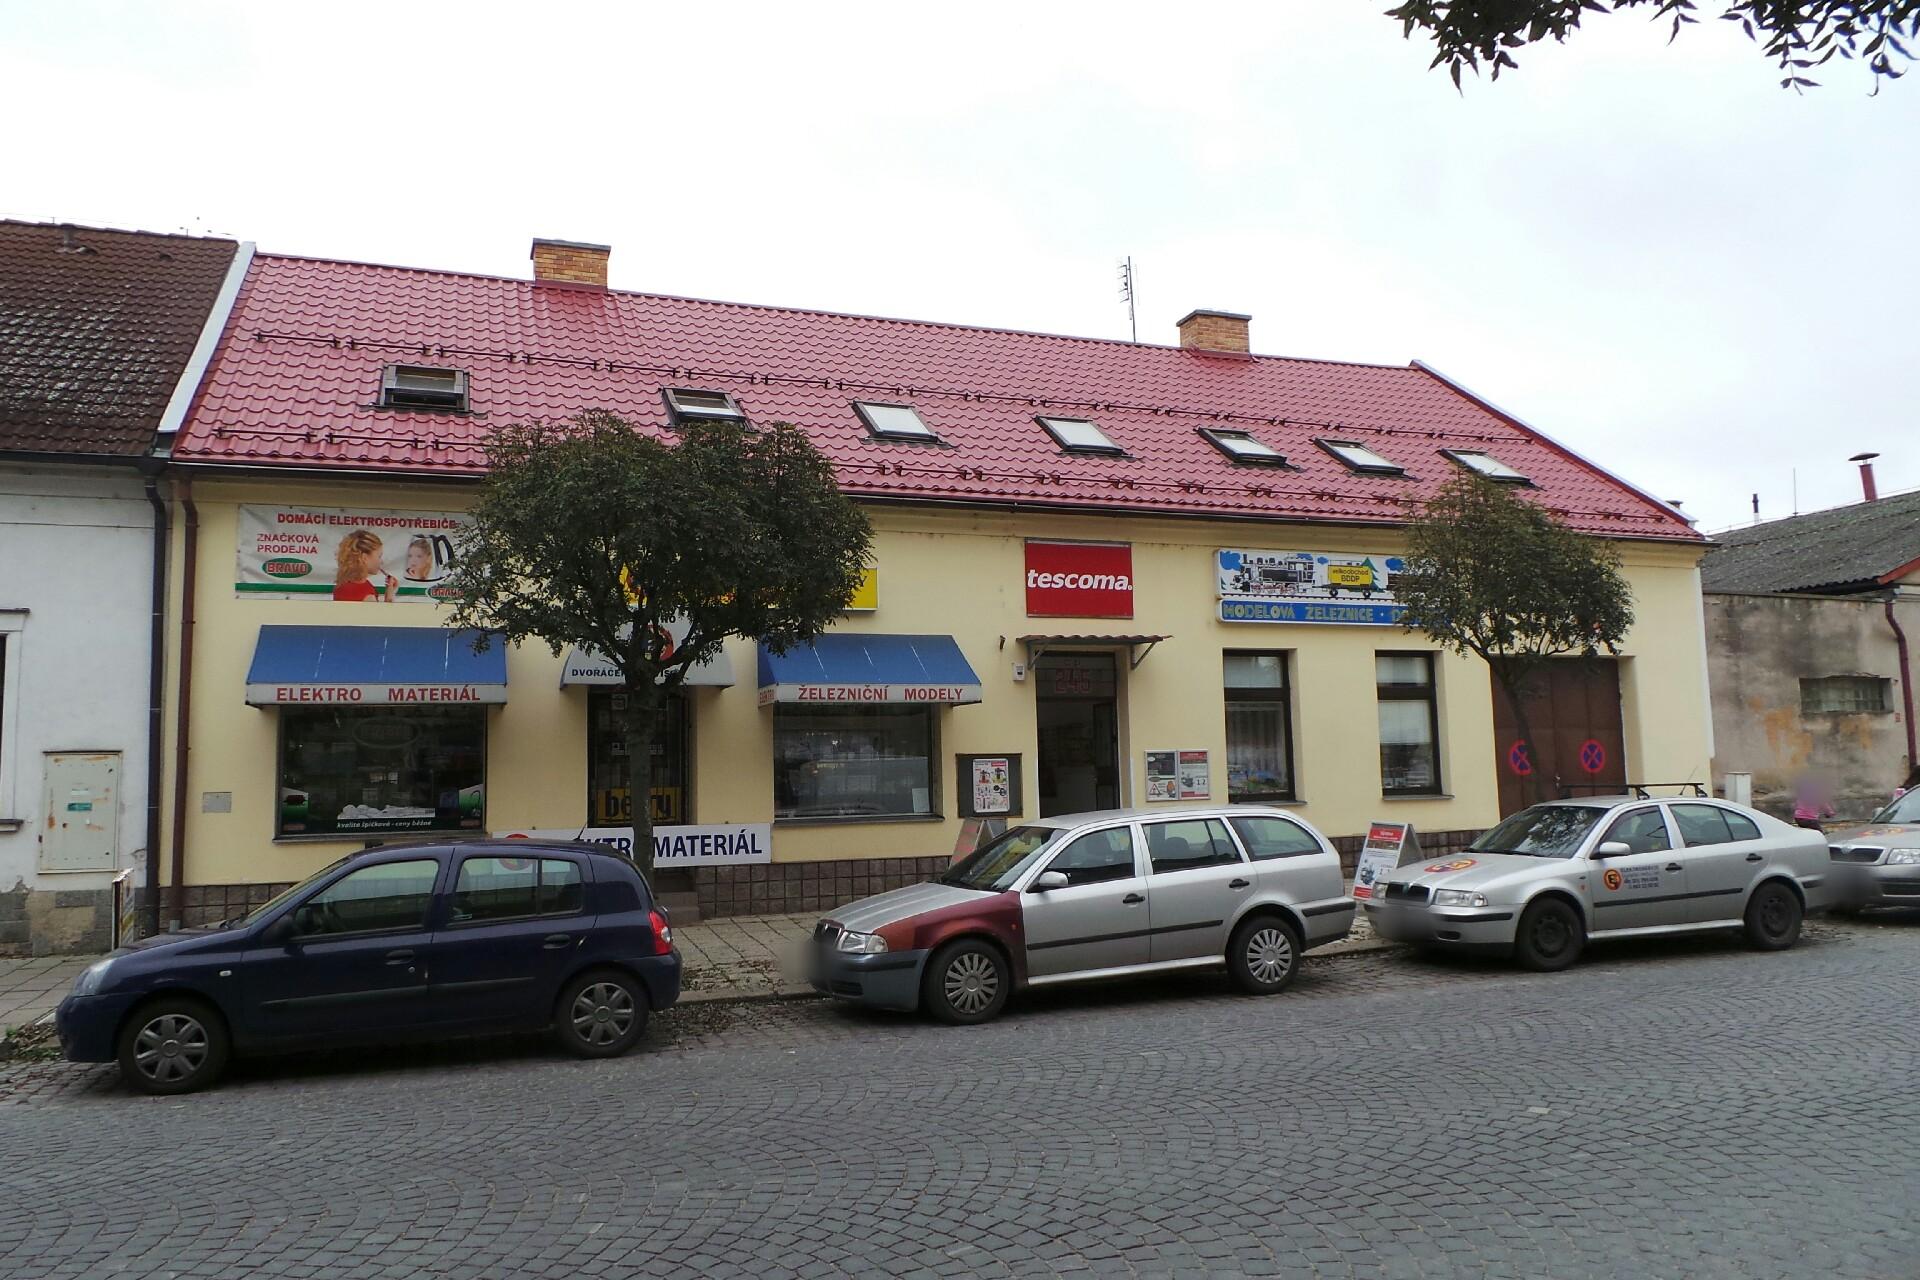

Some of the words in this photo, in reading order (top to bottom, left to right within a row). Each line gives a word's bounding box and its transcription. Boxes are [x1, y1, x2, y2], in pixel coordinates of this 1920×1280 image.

[277, 512, 325, 525] DOMÁCÍ
[256, 532, 319, 544] ZNAČKOVÁ
[256, 544, 318, 554] PRODEJNA
[266, 562, 308, 574] BRAVO
[1223, 603, 1295, 619] MODELOVÁ
[276, 687, 362, 701] ELEKTRO
[388, 684, 481, 701] MATERIÁL
[798, 685, 888, 701] ŽELEZNIČNÍ
[904, 687, 964, 701] MODELY
[652, 828, 762, 857] MATERIÁL
